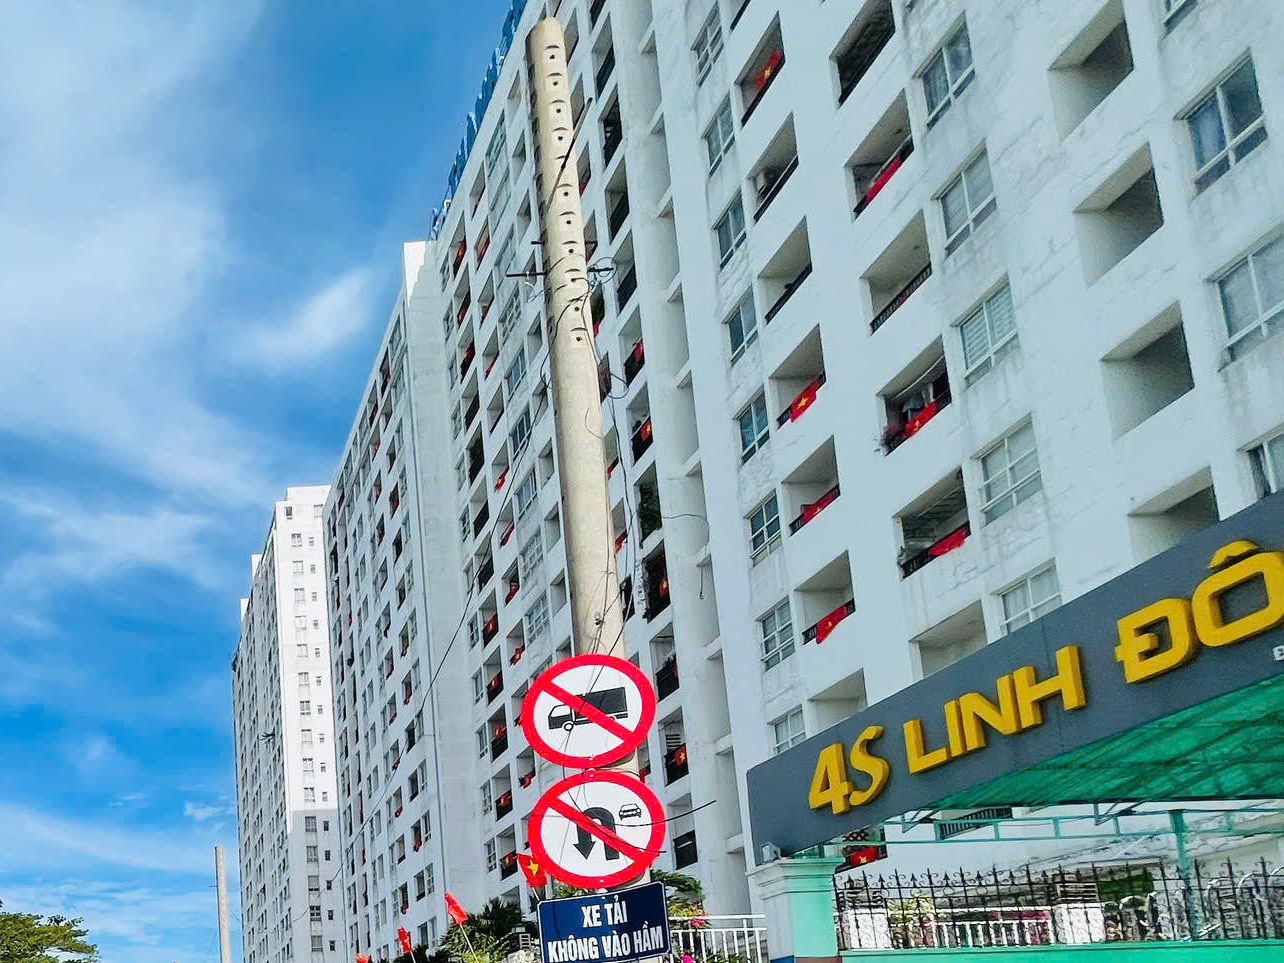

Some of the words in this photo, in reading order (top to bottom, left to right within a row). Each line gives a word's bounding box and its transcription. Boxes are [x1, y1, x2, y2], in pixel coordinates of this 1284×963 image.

[808, 725, 890, 815] 4S
[902, 645, 1087, 775] LINH
[1115, 540, 1284, 684] ĐÔ
[581, 904, 603, 928] XE
[604, 894, 628, 926] TẢI
[548, 935, 600, 963] KHÔNG
[602, 930, 631, 958] VÀO
[633, 921, 664, 954] HẦM
